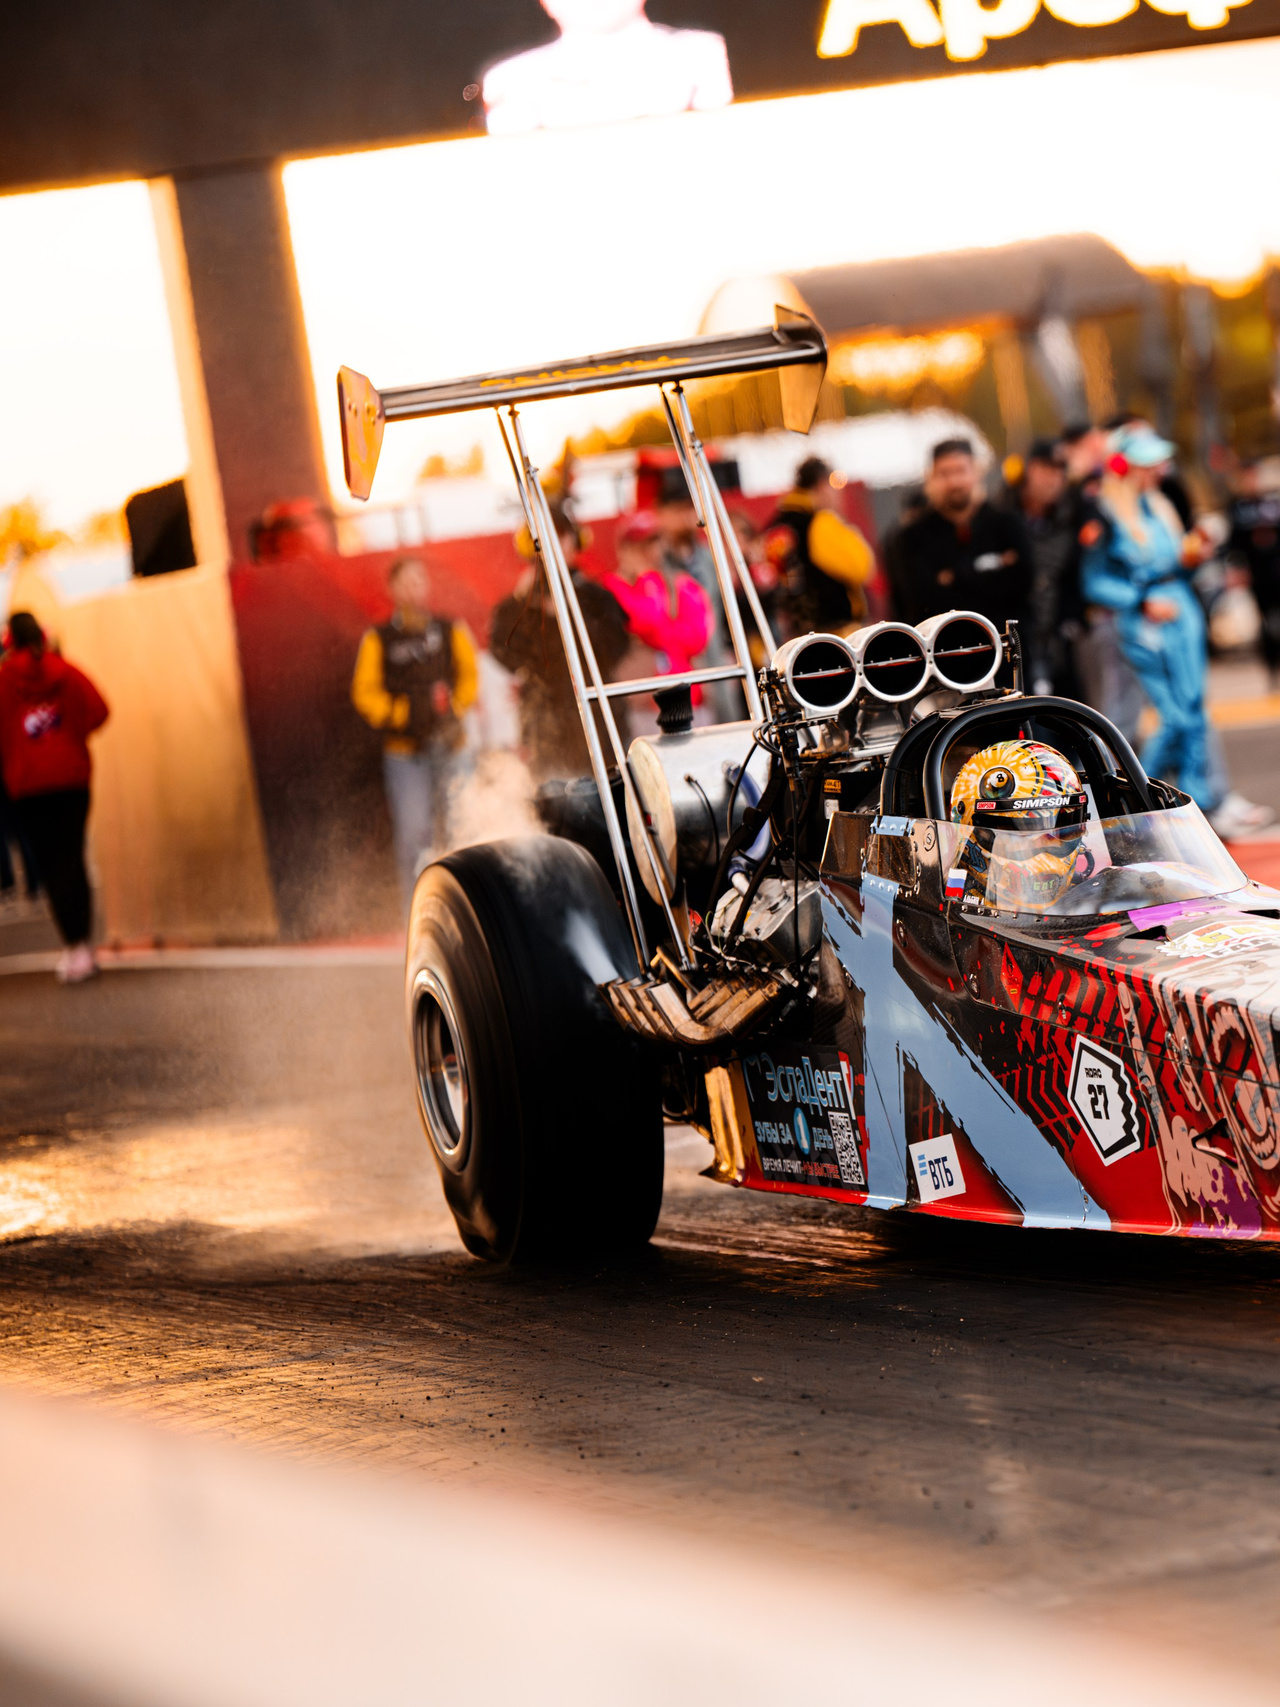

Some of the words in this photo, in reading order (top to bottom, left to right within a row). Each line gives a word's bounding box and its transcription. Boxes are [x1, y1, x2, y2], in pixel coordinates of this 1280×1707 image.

[1013, 796, 1071, 809] SIMPSON
[1087, 1084, 1110, 1120] 27
[755, 1121, 780, 1144] ЗУБЫ
[779, 1122, 795, 1145] ЗА
[812, 1126, 834, 1151] ДЕНЬ
[762, 1157, 783, 1172] ВРЕМЯ
[928, 1156, 954, 1190] ВТБ
